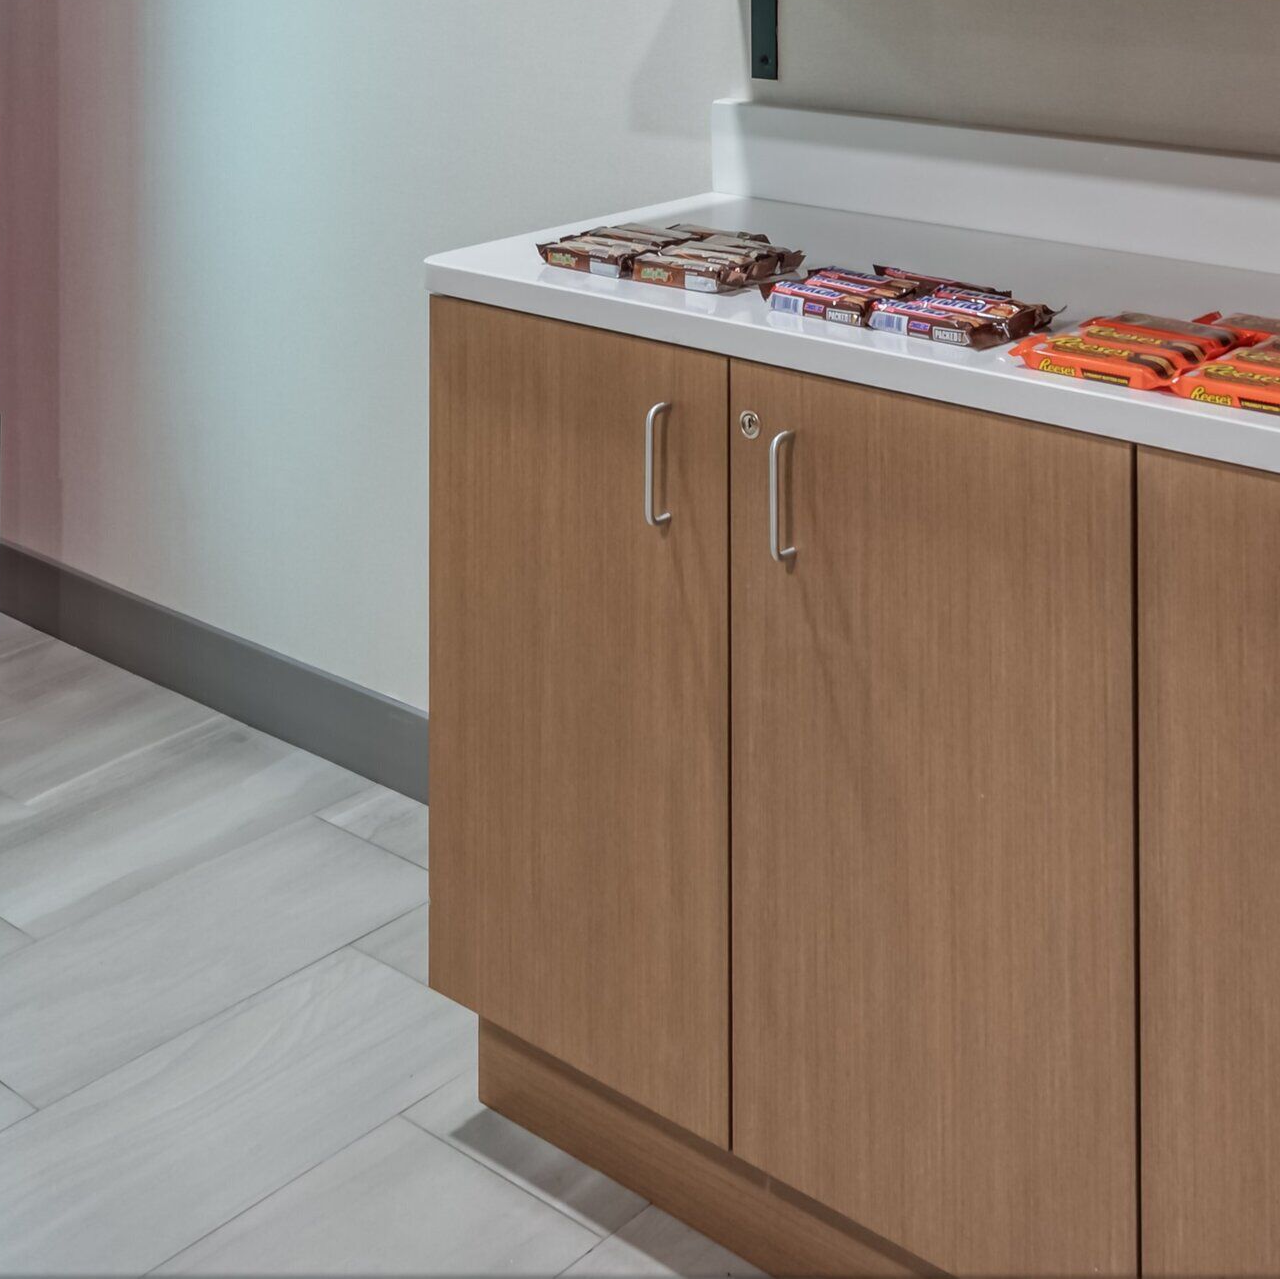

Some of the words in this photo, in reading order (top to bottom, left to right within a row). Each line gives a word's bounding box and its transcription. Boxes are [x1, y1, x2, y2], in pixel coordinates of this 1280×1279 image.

[827, 310, 849, 322] PACKED
[935, 329, 957, 342] PACKED
[1039, 358, 1075, 377] Reese's
[1190, 386, 1232, 406] Reese's
